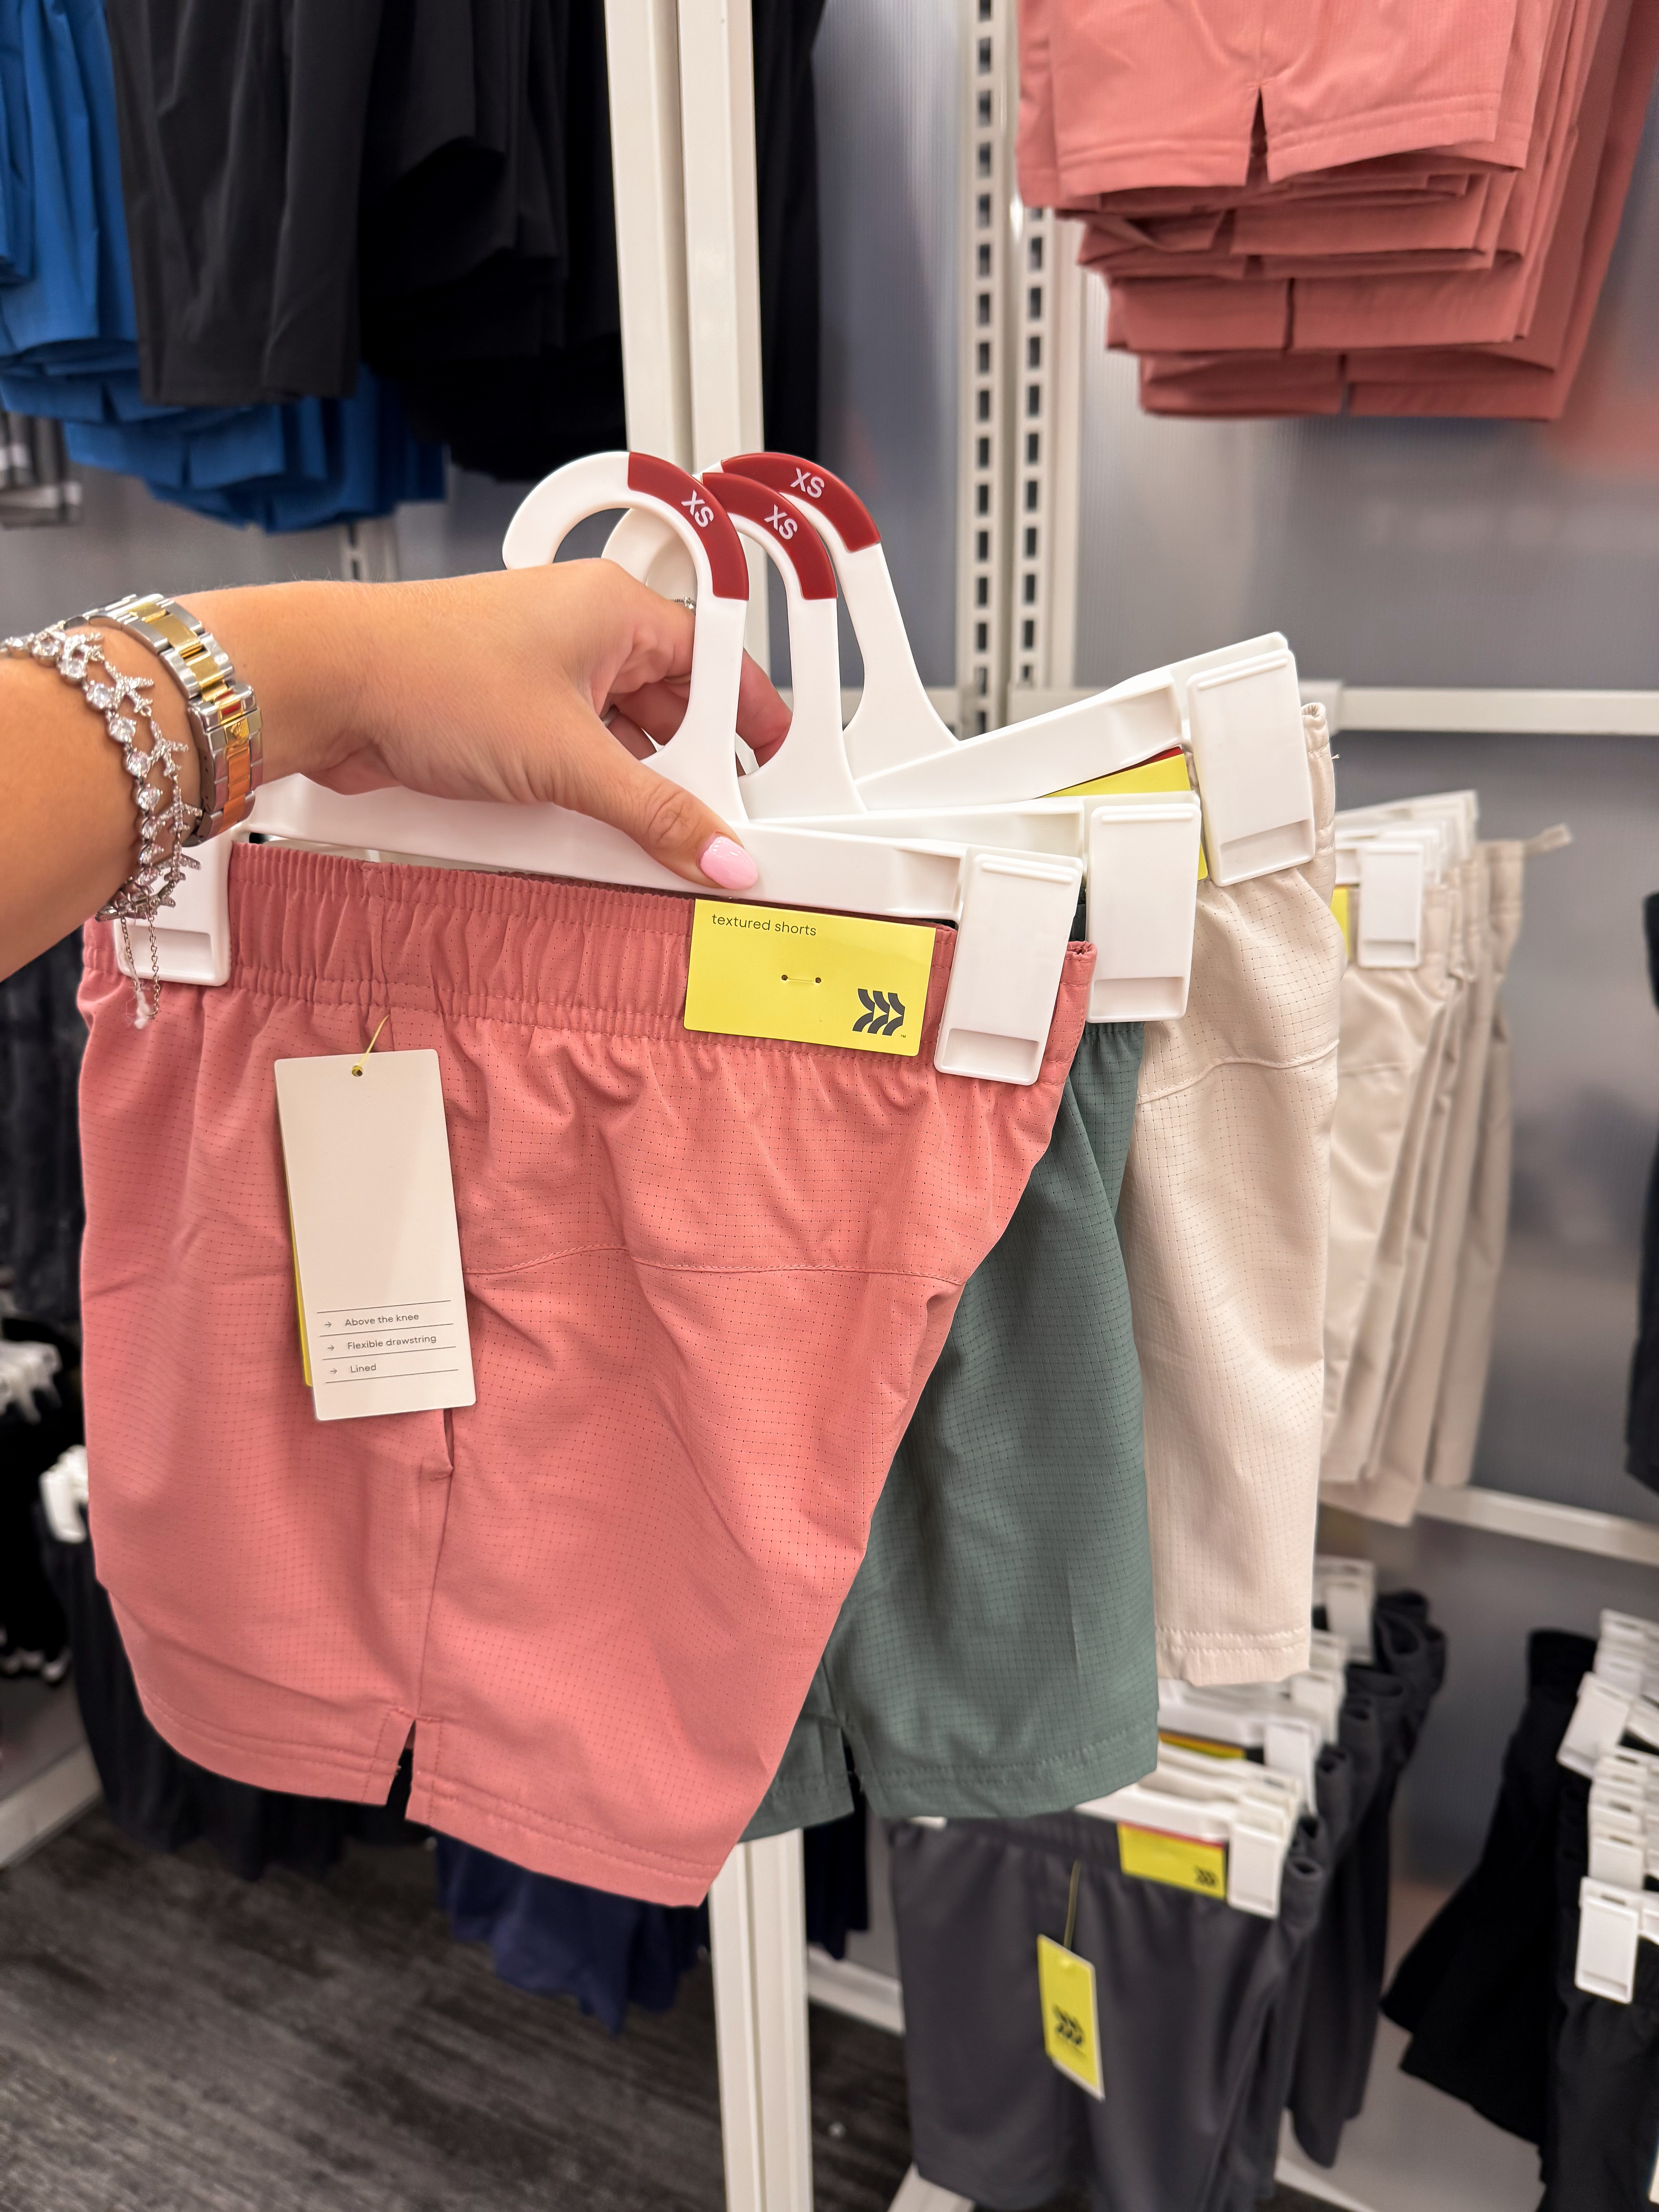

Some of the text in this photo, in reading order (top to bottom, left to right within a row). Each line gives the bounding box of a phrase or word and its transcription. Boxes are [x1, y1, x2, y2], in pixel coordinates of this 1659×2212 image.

[790, 468, 825, 498] XS
[681, 489, 714, 527] XS
[764, 505, 798, 539] XS
[712, 914, 816, 936] textured shorts
[345, 1318, 375, 1326] Above
[378, 1315, 393, 1323] the
[348, 1335, 436, 1350] Flexible drawstring
[350, 1364, 376, 1373] Lined
